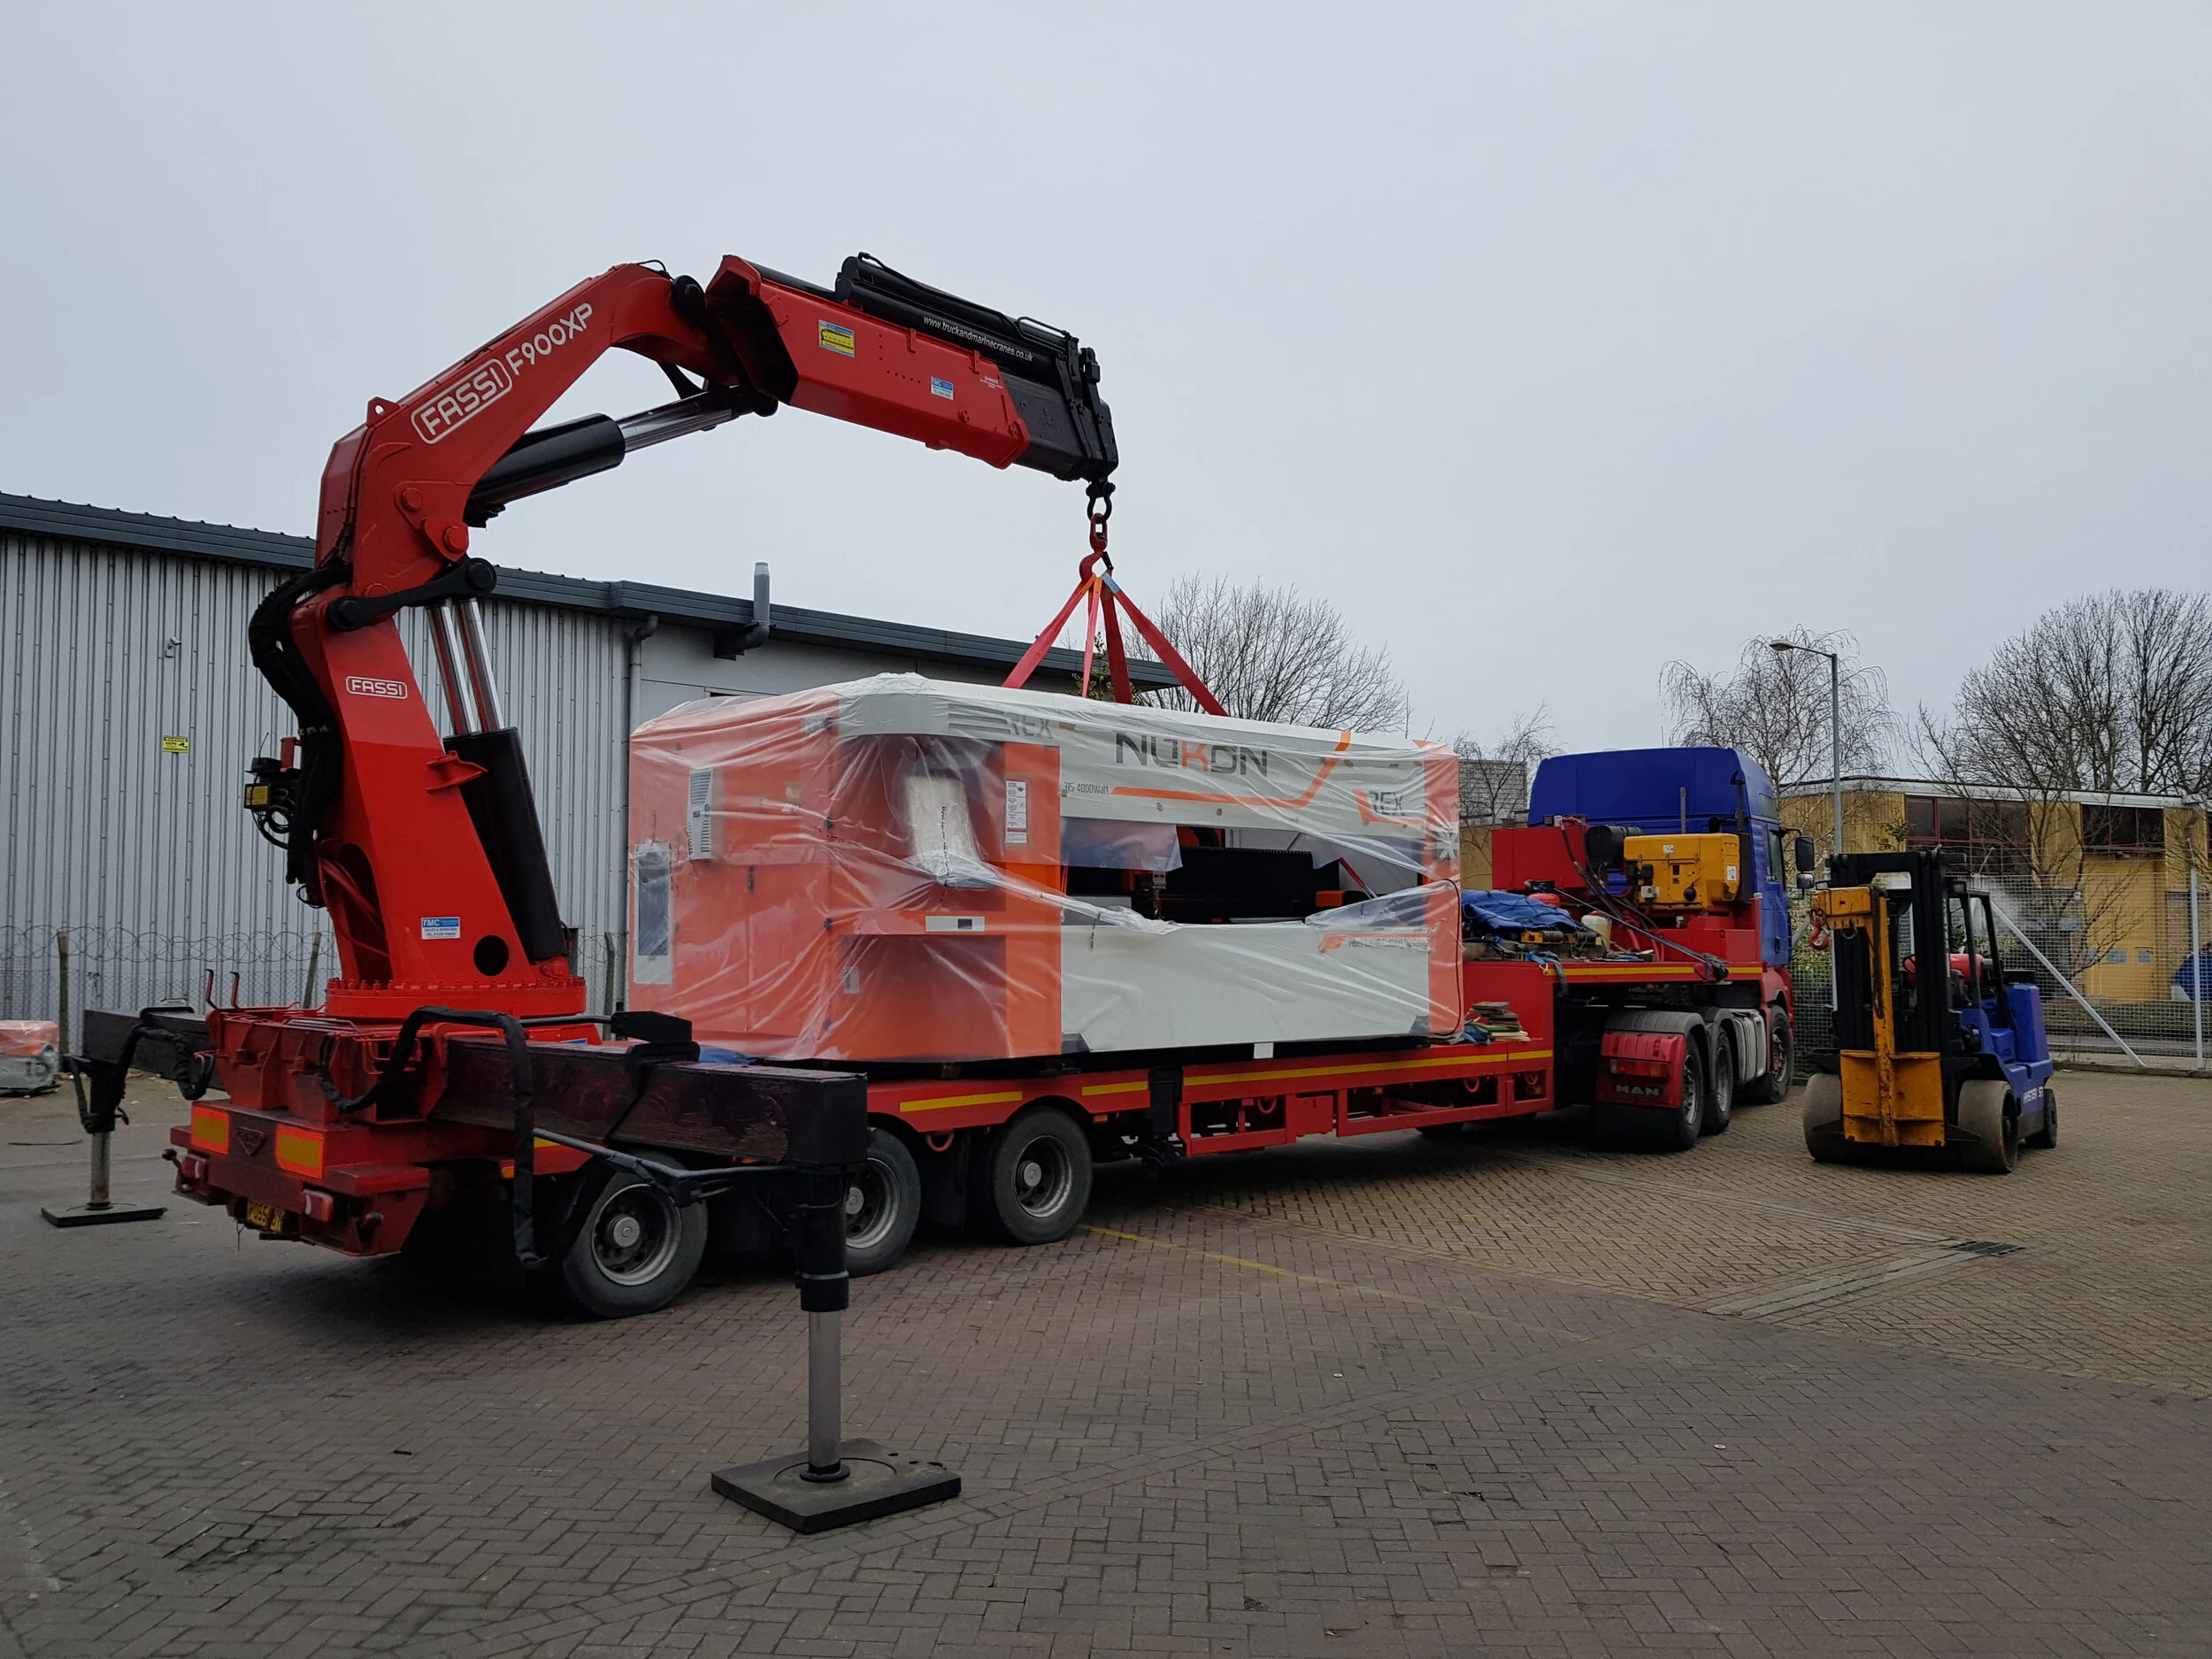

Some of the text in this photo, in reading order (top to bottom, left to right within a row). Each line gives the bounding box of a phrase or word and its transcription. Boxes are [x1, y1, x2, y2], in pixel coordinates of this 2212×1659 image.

[923, 316, 1033, 362] www.truckandmarinecranes.co.uk
[420, 303, 593, 435] FASSI F900XP
[351, 679, 403, 696] FASSI
[1116, 732, 1268, 778] NUKON
[1368, 790, 1407, 816] REX
[423, 918, 441, 927] TMC
[1616, 1085, 1660, 1096] MAN
